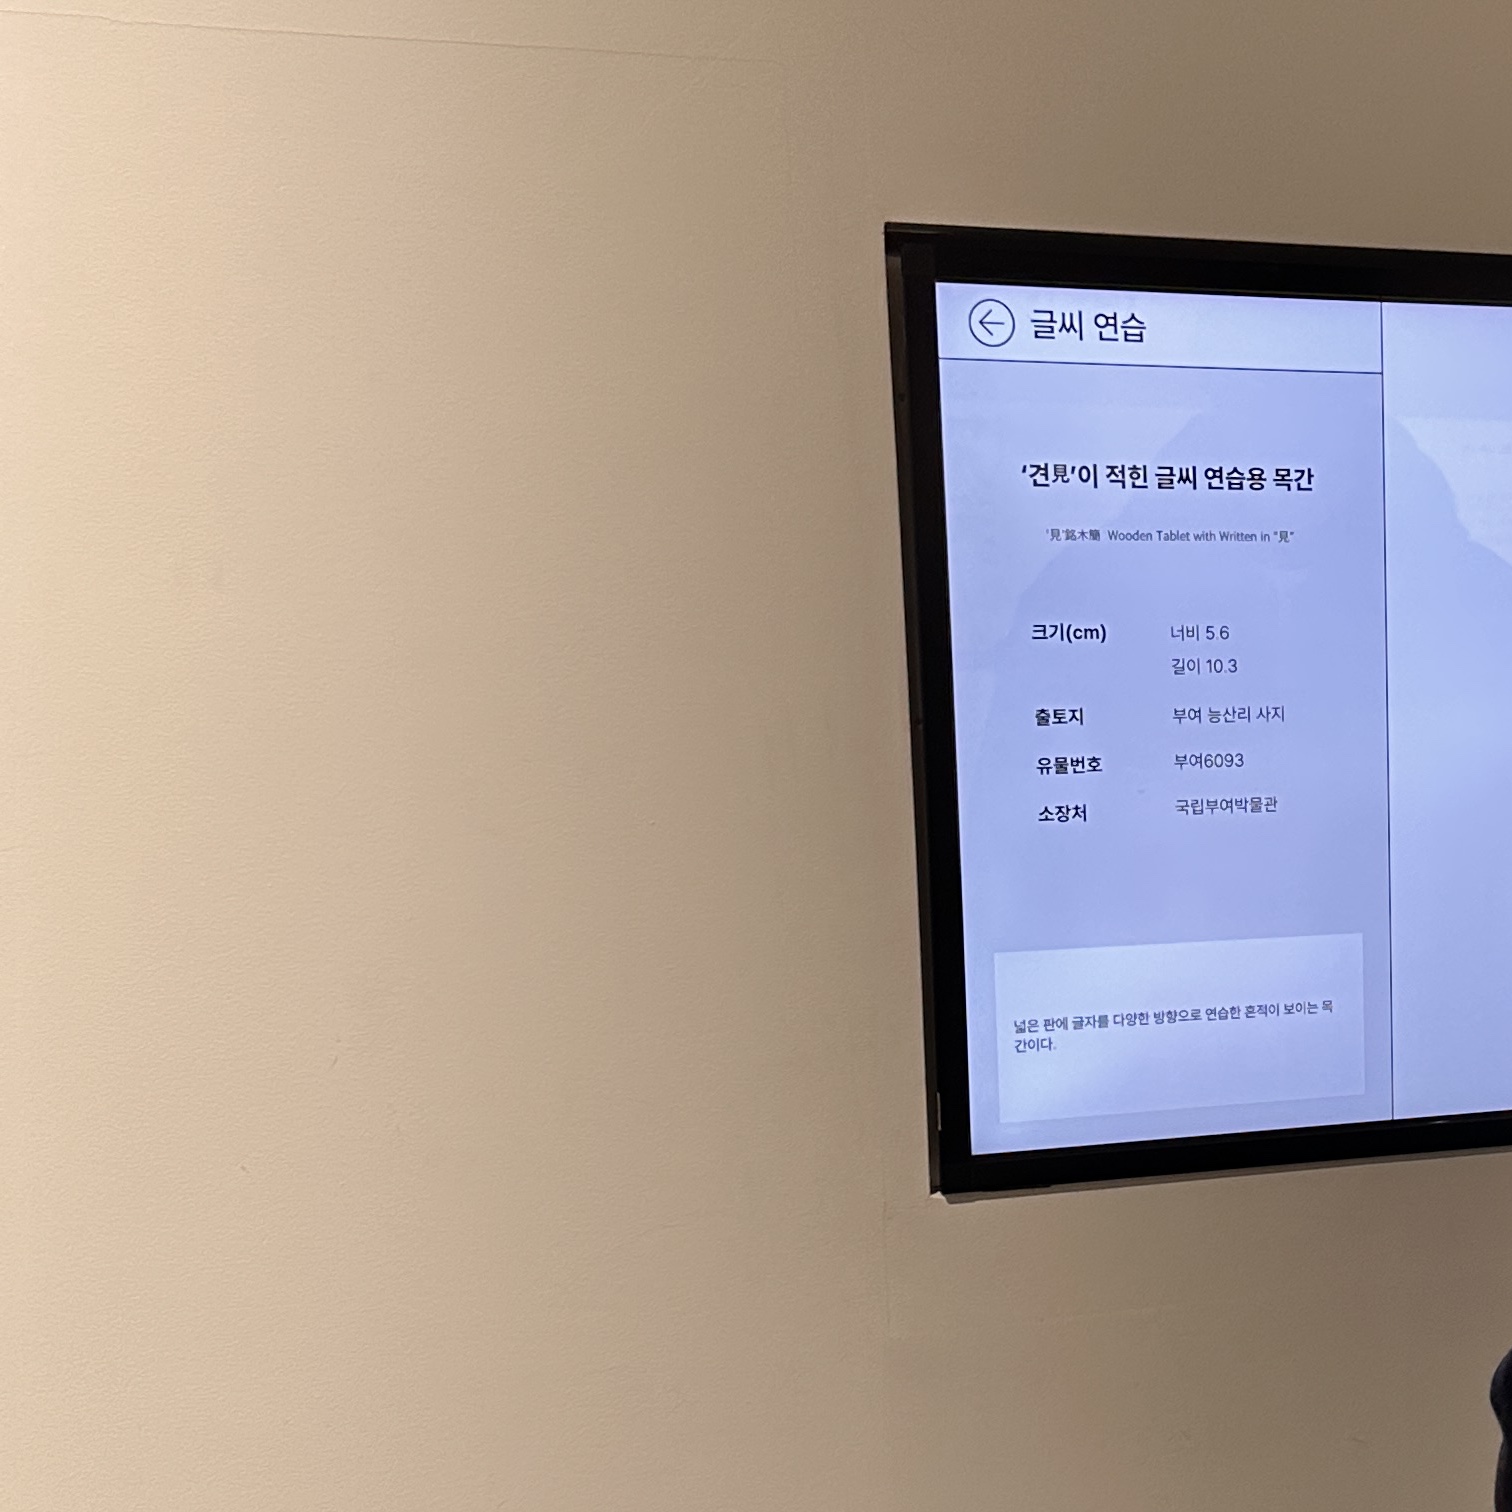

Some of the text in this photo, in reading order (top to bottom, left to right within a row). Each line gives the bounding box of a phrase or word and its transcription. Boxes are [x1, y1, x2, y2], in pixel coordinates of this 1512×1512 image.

[1030, 310, 1147, 343] 글씨 연습
[1105, 465, 1149, 490] 적힌
[1154, 465, 1198, 491] 글씨
[1204, 466, 1267, 491] 연습용
[1272, 467, 1315, 492] 목간
[1108, 529, 1153, 542] Wooden
[1157, 530, 1191, 542] Tablet
[1193, 530, 1217, 543] with
[1219, 531, 1257, 543] Written
[1260, 531, 1271, 543] in
[1031, 623, 1107, 644] 크기(cm)
[1170, 625, 1230, 642] 너비 5.6
[1171, 658, 1238, 675] 길이 10.3
[1035, 707, 1084, 726] 출토지
[1172, 706, 1285, 724] 부여 능산리 사지
[1036, 756, 1103, 775] 유물번호
[1174, 753, 1244, 770] 부여6093
[1038, 804, 1087, 823] 소장처
[1175, 797, 1278, 815] 국립부여박물관
[1014, 1000, 1333, 1034] 넓은 판에 글자를 다양한 방향으로 연습한 흔적이 보이는 목
[1014, 1037, 1057, 1053] 간이다.
